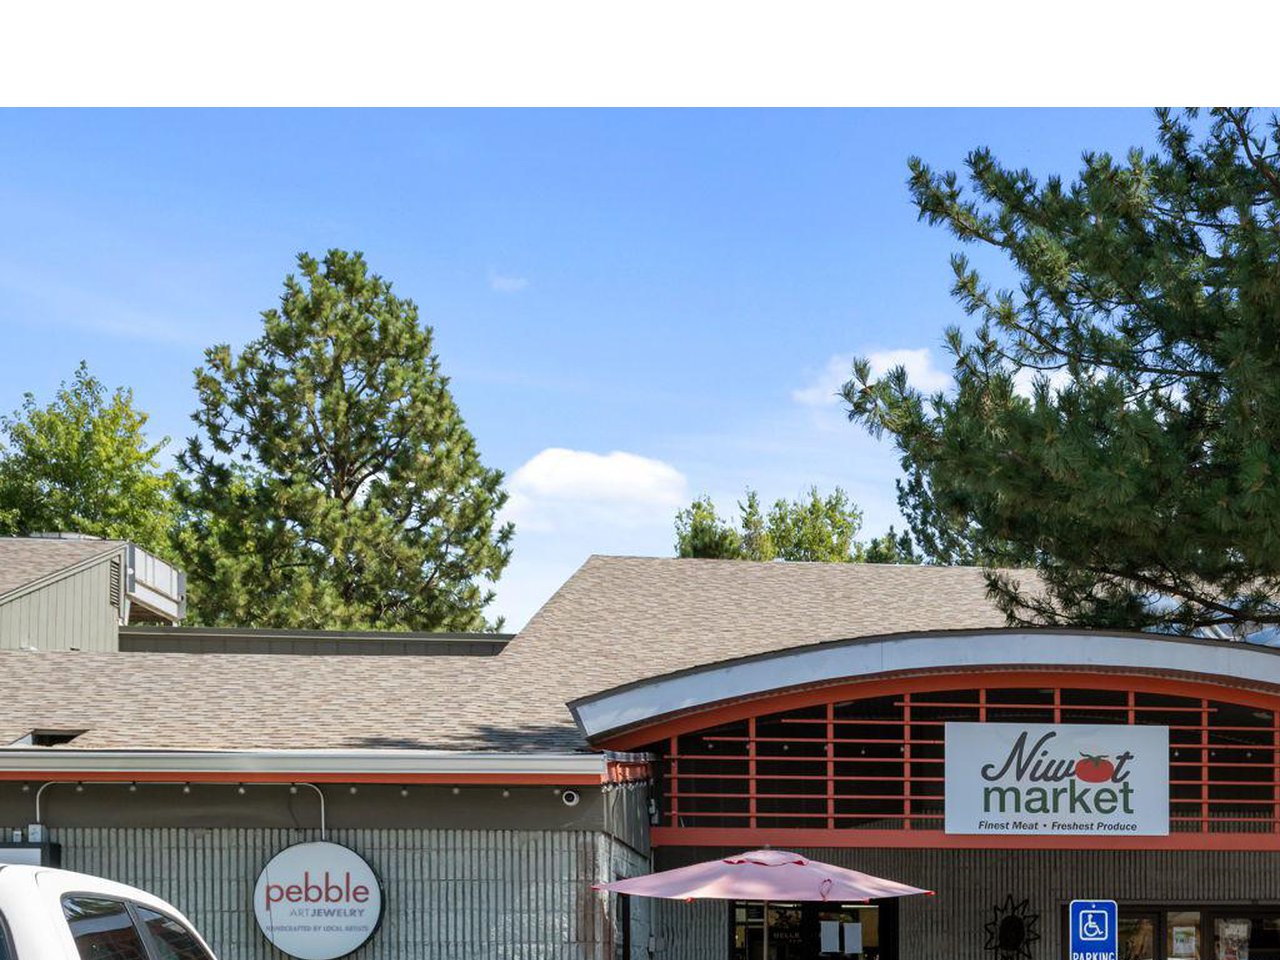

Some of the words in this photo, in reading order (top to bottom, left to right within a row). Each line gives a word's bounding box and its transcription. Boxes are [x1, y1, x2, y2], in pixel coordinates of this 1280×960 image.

[983, 779, 1134, 814] market
[978, 820, 1009, 830] Finest
[1012, 821, 1039, 830] Meat
[1051, 821, 1094, 831] Freshest
[1096, 822, 1137, 831] Produce
[266, 871, 369, 911] pebble
